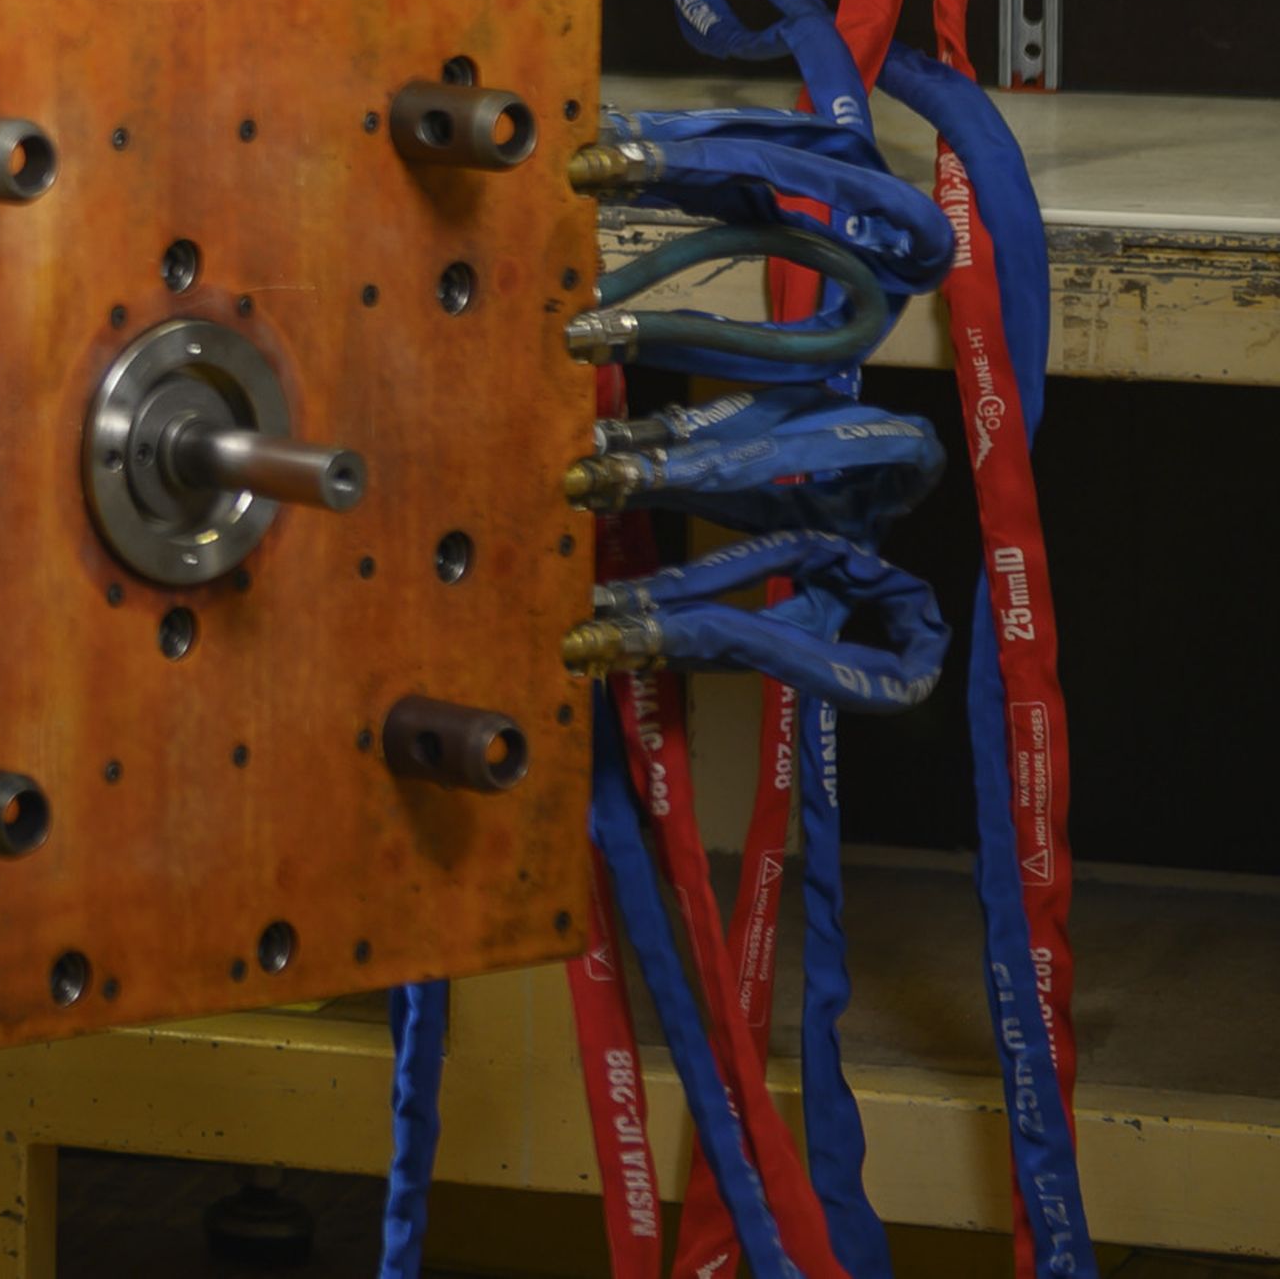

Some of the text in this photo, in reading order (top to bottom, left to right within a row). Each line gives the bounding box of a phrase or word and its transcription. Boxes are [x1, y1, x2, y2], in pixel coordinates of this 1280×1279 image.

[1018, 751, 1030, 807] WARNING
[1031, 708, 1047, 846] HIGH PRESSURE HOSES
[621, 1149, 658, 1239] MSHA
